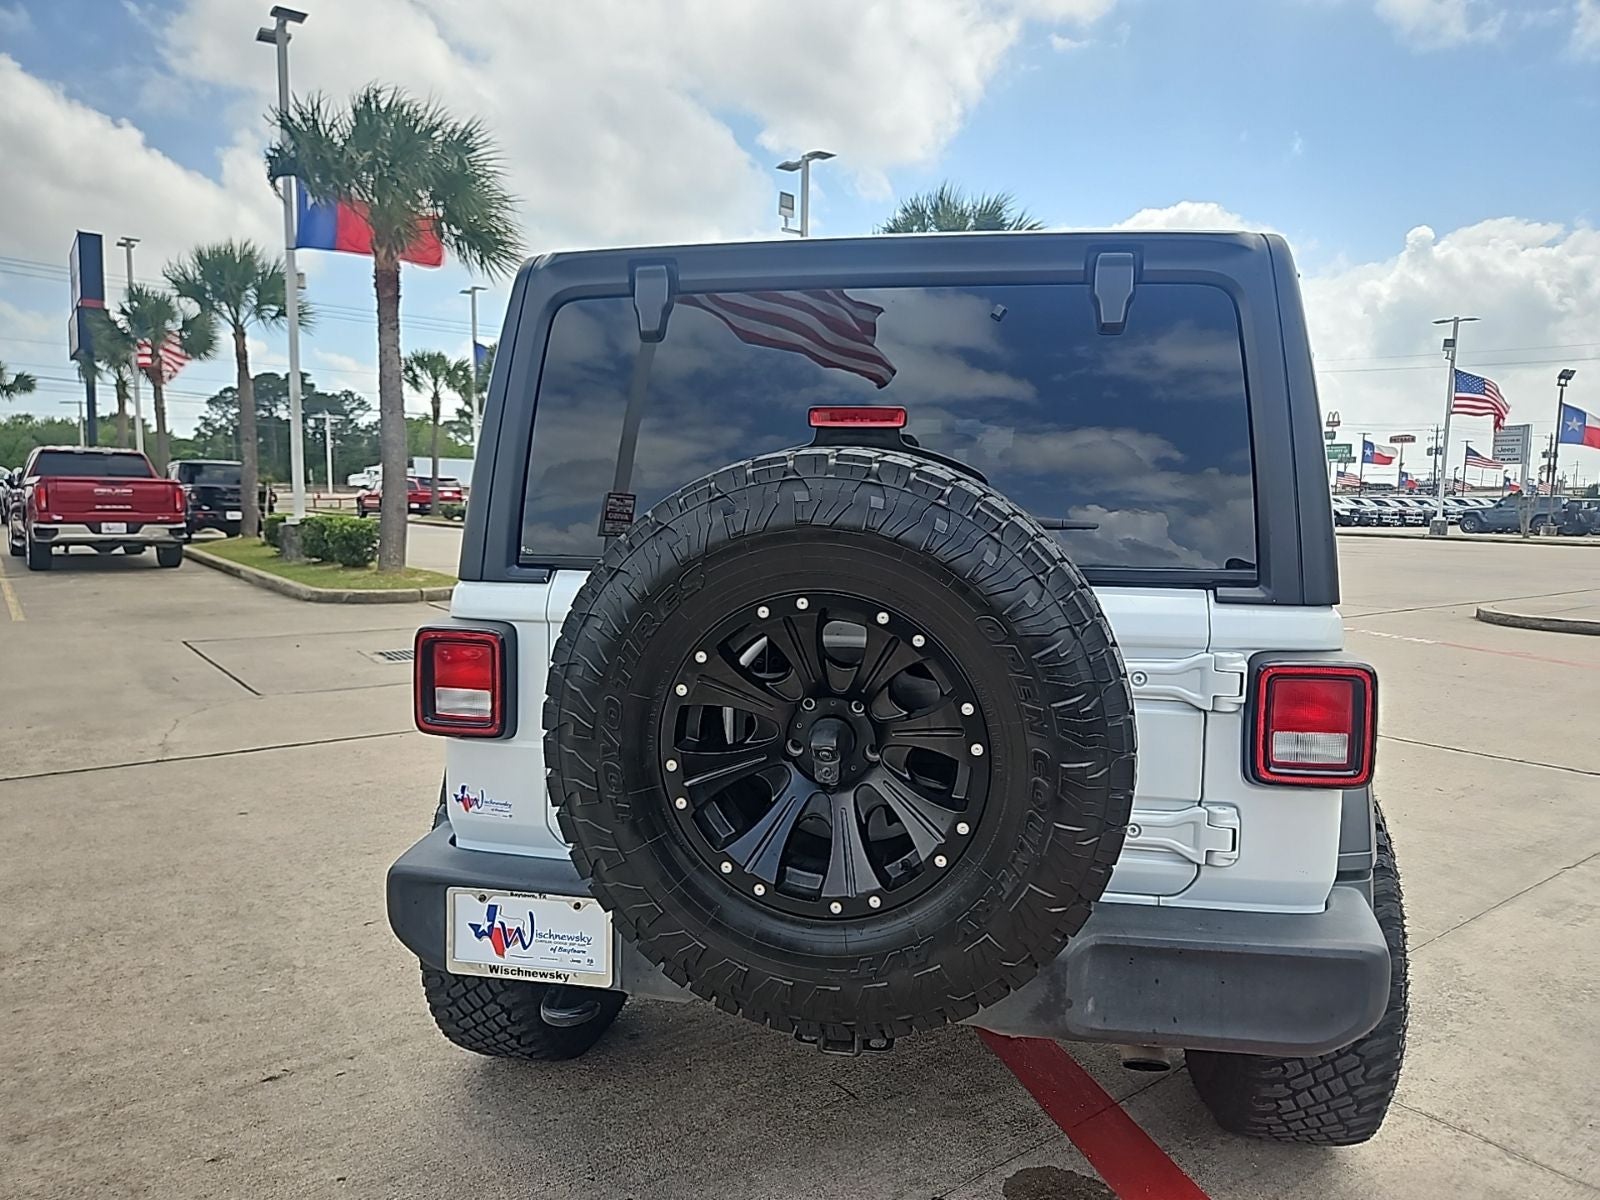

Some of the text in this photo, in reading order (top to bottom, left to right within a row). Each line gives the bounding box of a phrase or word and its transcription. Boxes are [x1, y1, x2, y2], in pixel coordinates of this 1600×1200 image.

[606, 560, 706, 691] TIRES
[973, 612, 1047, 732] OPEN
[488, 964, 570, 982] Wischnewsky
[550, 945, 557, 953] of
